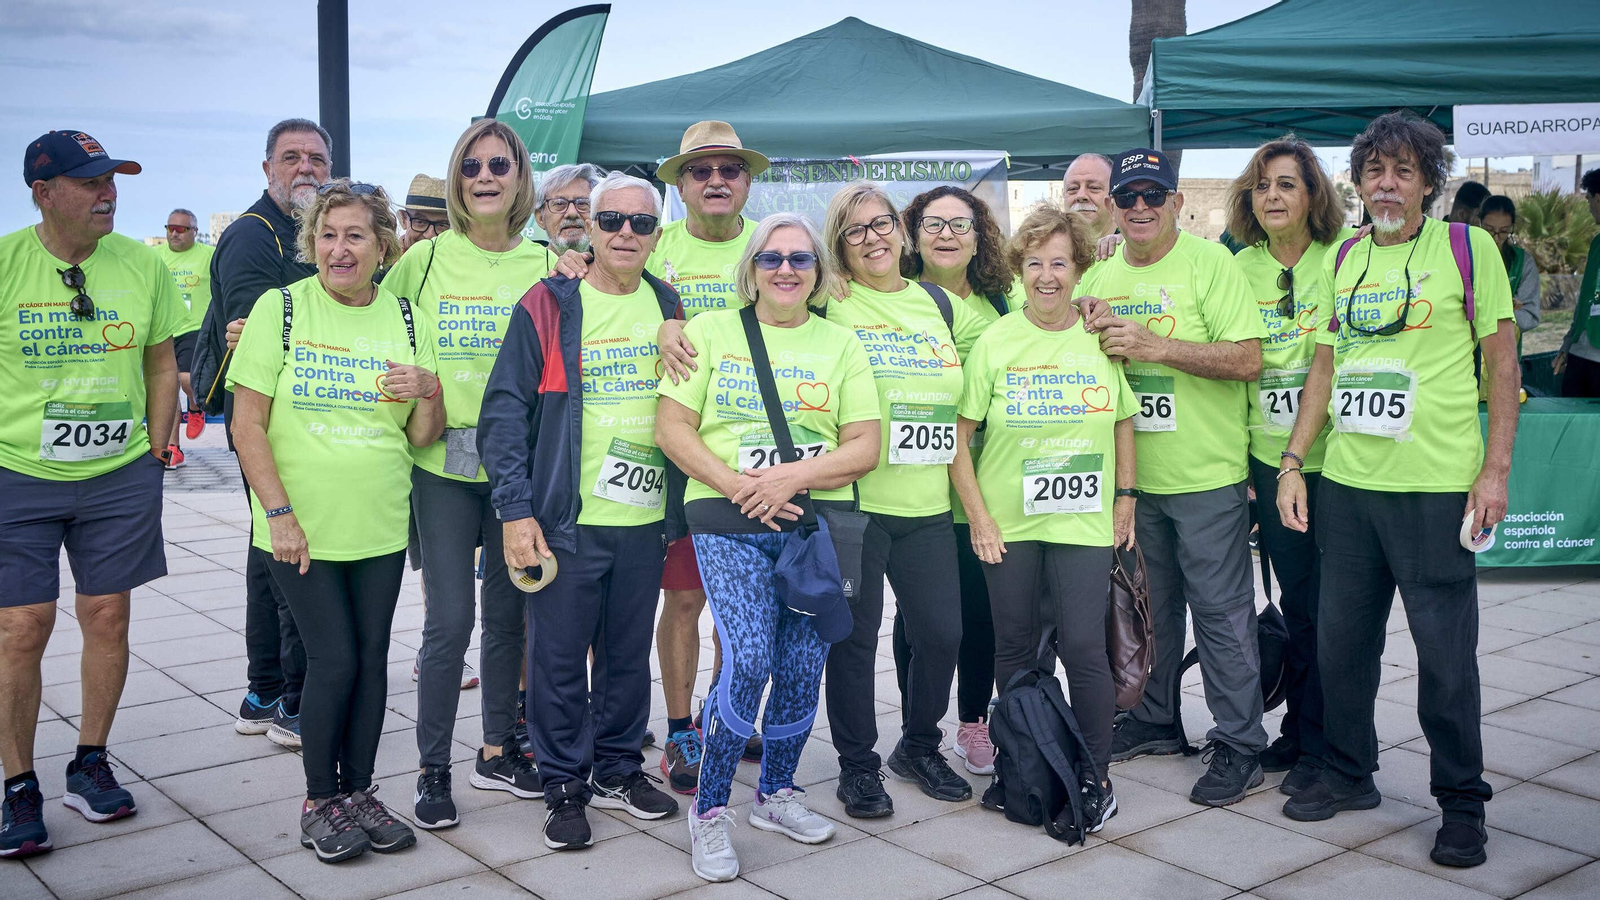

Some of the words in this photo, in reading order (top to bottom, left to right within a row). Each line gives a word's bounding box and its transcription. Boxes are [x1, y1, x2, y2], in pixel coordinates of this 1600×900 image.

[1466, 118, 1600, 136] GUARDARROPA
[1121, 154, 1144, 167] ESP
[790, 160, 972, 182] SENDERISMO
[696, 282, 736, 293] marc
[439, 301, 459, 314] En
[465, 304, 515, 316] marc
[682, 295, 726, 308] ontra
[1337, 296, 1348, 310] En
[18, 310, 43, 324] En
[49, 307, 119, 322] maha
[1339, 307, 1381, 324] ontra
[438, 317, 496, 332] contra
[19, 325, 83, 340] contra
[856, 330, 879, 341] En
[882, 332, 939, 344] marca
[1270, 328, 1301, 344] ncer
[22, 342, 41, 356] el
[45, 341, 109, 356] cáncer
[302, 340, 318, 348] CÁDIZ
[326, 344, 351, 352] MARCHA
[438, 333, 454, 347] el
[459, 333, 504, 349] cánc
[295, 347, 317, 363] En
[582, 348, 601, 362] En
[606, 342, 660, 360] march
[864, 344, 917, 355] contra
[868, 353, 886, 366] el
[889, 356, 944, 369] cáncer
[294, 367, 355, 384] contra
[582, 362, 638, 376] contra
[720, 361, 740, 374] En
[746, 366, 815, 380] mrcha
[63, 376, 118, 387] HYUNDAI
[582, 378, 598, 393] el
[718, 377, 760, 394] cont
[1032, 371, 1097, 385] marcha
[292, 381, 310, 397] el
[315, 384, 382, 404] cáncer
[906, 392, 953, 401] HYUNDAI
[716, 391, 731, 407] el
[735, 394, 803, 412] cáer
[1006, 402, 1022, 415] el
[1027, 402, 1088, 415] cáncer
[1140, 396, 1171, 418] 56
[1341, 391, 1405, 418] 2105
[621, 415, 656, 425] HYUN
[53, 422, 127, 447] 2034
[898, 424, 954, 450] 2055
[614, 440, 630, 448] Cádiz
[1041, 438, 1093, 448] HYUNDAI
[608, 462, 664, 494] 2094
[1034, 474, 1098, 501] 2093
[1504, 511, 1564, 522] asociación
[1504, 525, 1555, 538] española
[1504, 539, 1540, 549] contra
[1543, 538, 1553, 548] el
[1557, 537, 1595, 548] cáncer
